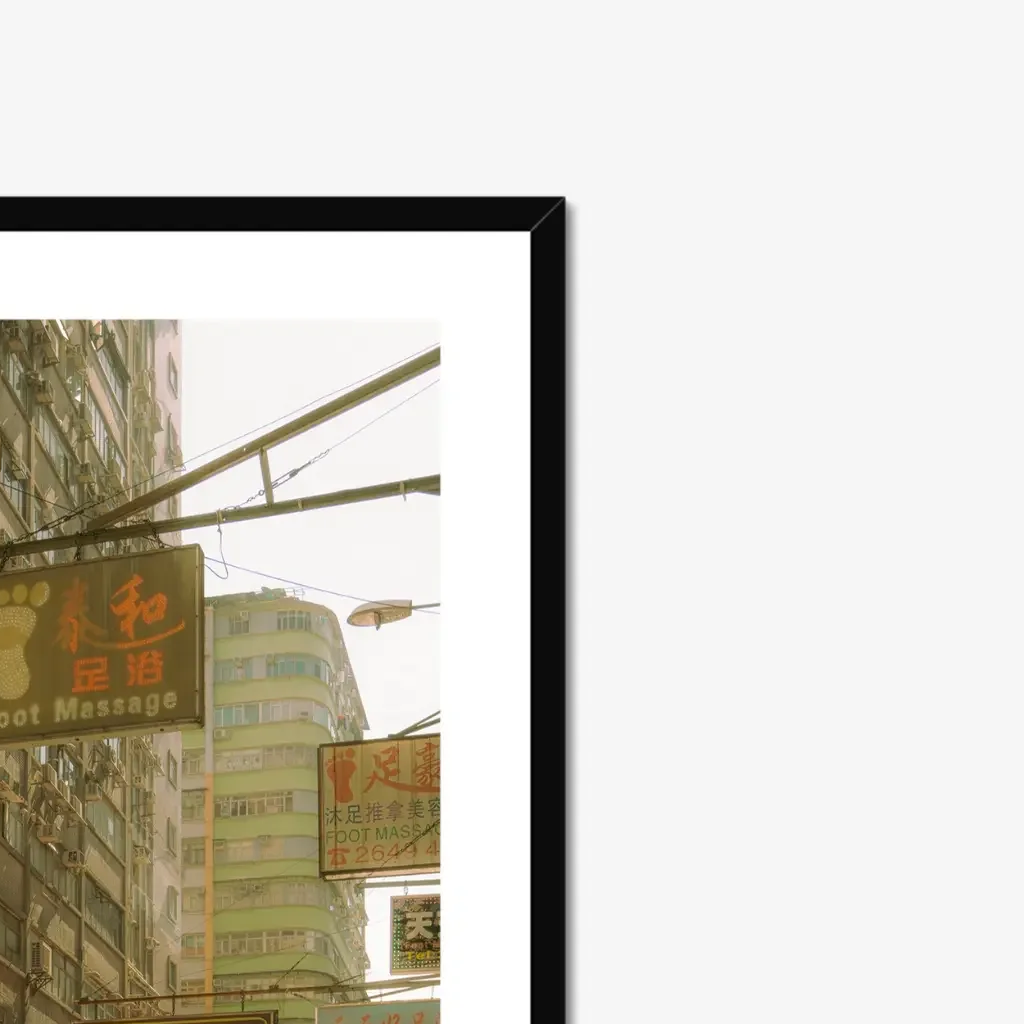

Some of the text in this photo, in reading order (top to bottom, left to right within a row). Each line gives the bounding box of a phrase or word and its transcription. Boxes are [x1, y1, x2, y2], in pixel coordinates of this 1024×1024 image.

[71, 650, 164, 693] 足浴
[54, 691, 178, 724] Massage
[326, 828, 372, 845] FOOT
